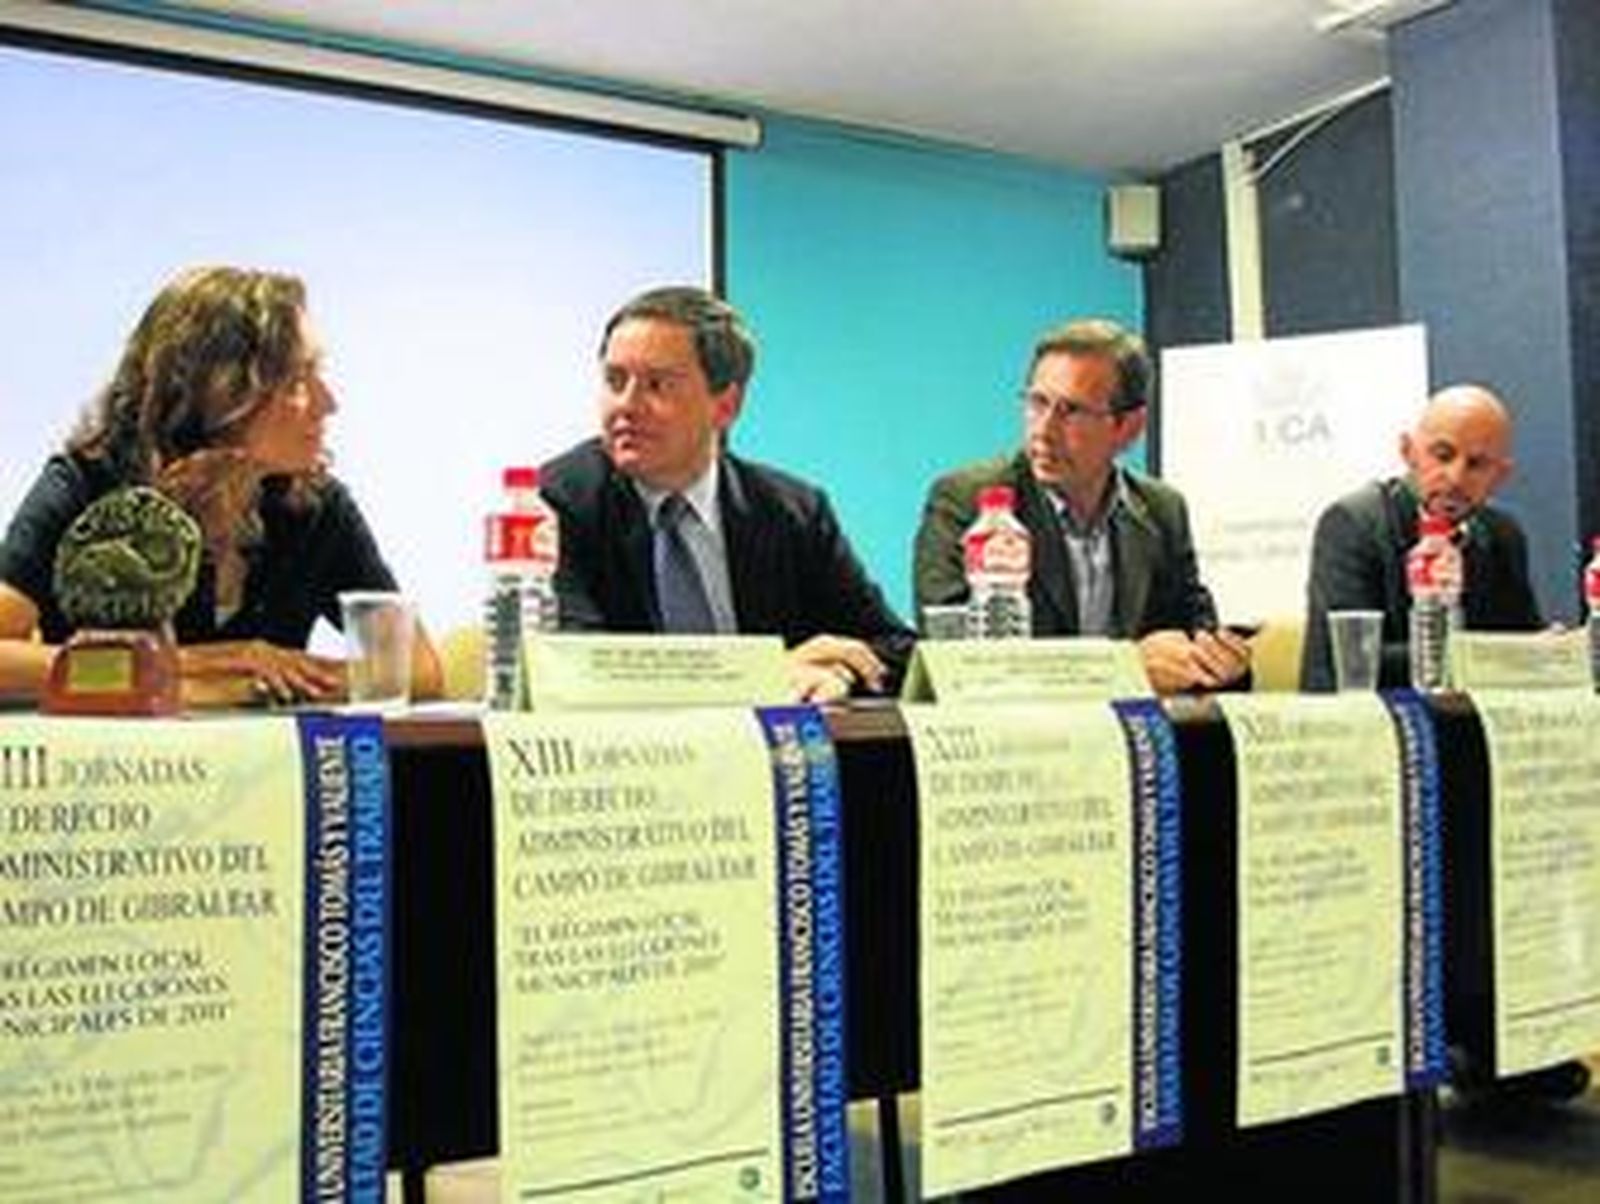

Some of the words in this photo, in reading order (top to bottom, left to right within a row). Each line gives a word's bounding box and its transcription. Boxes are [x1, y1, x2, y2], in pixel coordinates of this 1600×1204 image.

[57, 755, 208, 788] JORNADAS
[508, 738, 577, 778] XIII
[9, 801, 152, 835] DERECHO
[220, 842, 269, 875] DEL
[76, 893, 116, 924] DE
[121, 887, 278, 922] GIBRALTAR
[353, 872, 383, 927] DEL
[318, 923, 348, 1040] FRANCISCO
[353, 933, 384, 1071] CIENCIAS
[353, 1079, 383, 1116] DE
